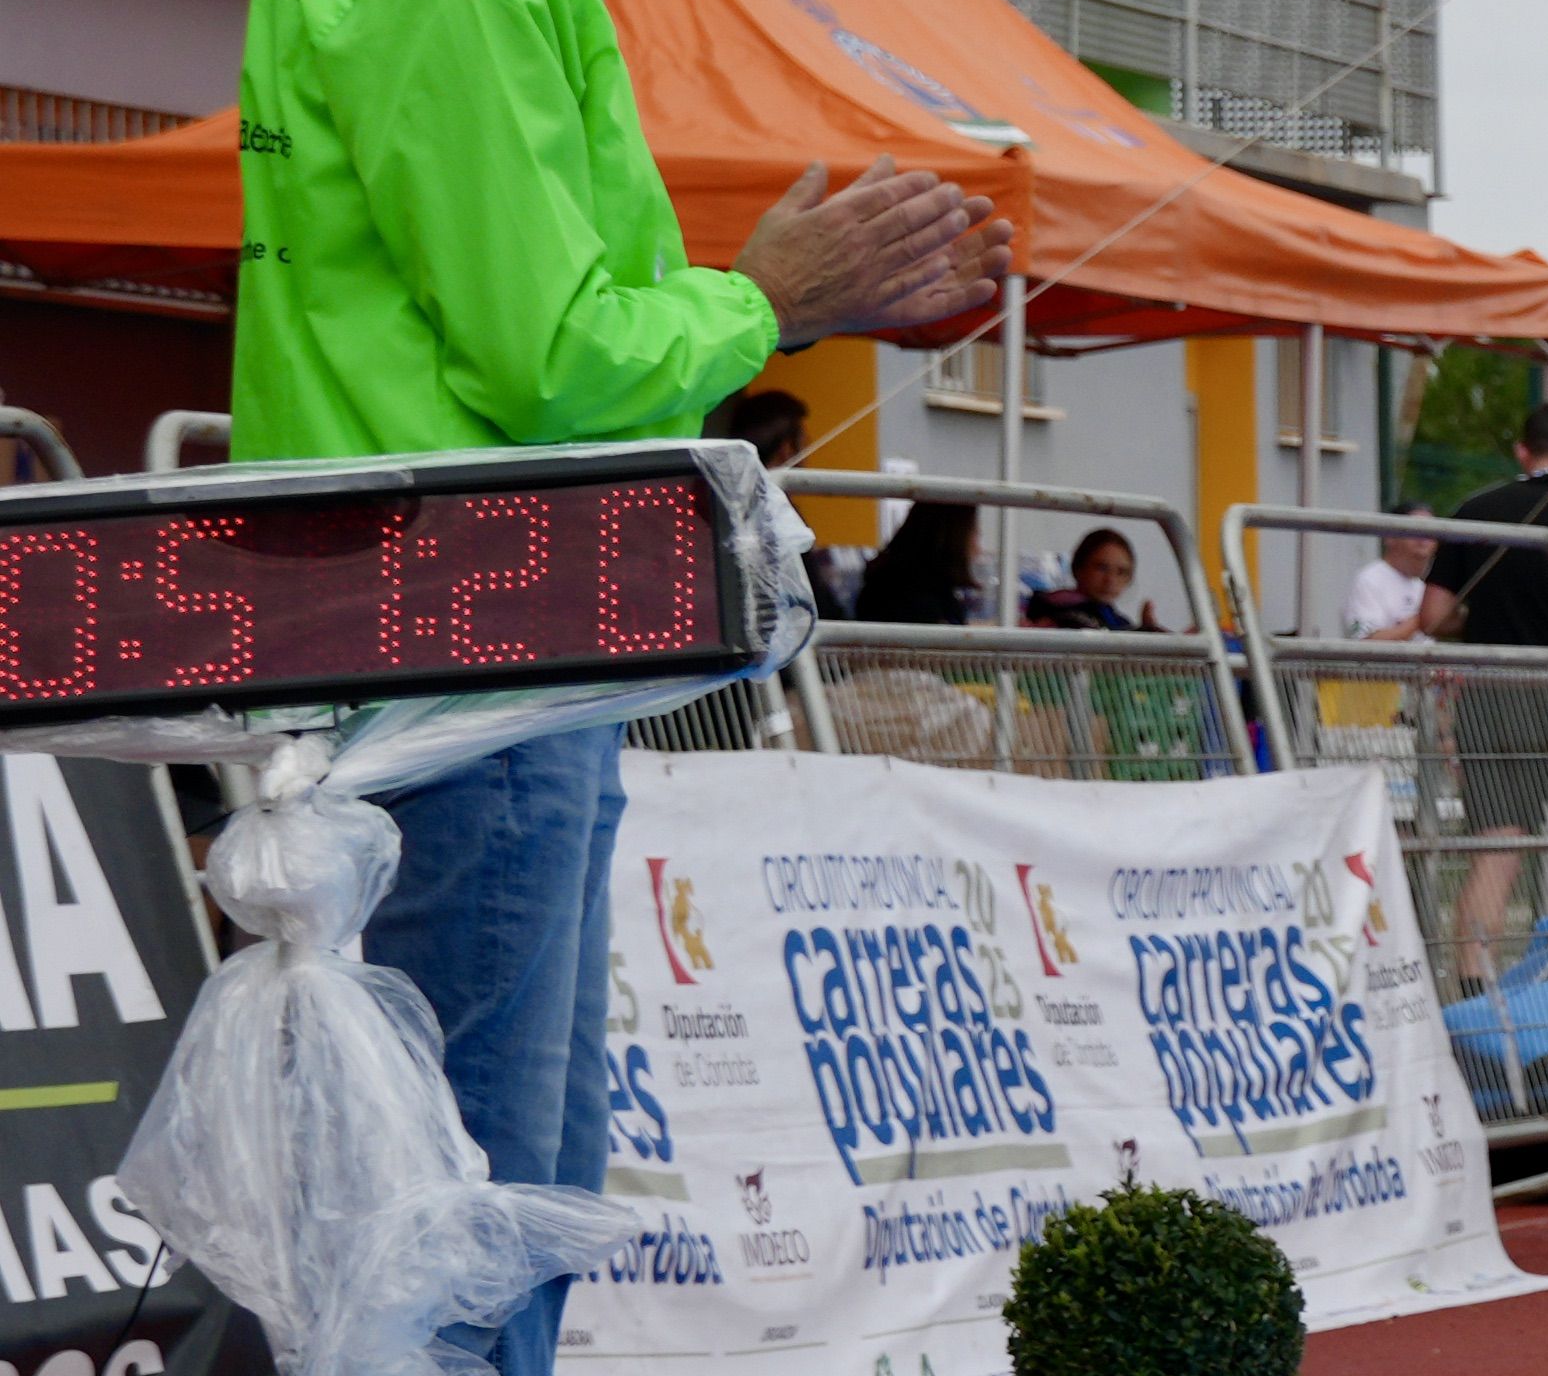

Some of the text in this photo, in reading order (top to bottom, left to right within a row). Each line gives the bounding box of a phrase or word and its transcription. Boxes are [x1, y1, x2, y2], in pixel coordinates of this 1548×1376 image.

[763, 854, 961, 913] CIRCUITO PROVINCIAL
[1109, 863, 1297, 921] CIRCUITO PROVINCIAL
[662, 1003, 749, 1042] Diputación
[784, 923, 993, 1040] carreras
[1129, 925, 1334, 1027] carreras
[803, 1025, 1055, 1187] populares
[1149, 1001, 1376, 1157] populares
[862, 1190, 985, 1286] Diputación
[974, 1189, 1012, 1252] de
